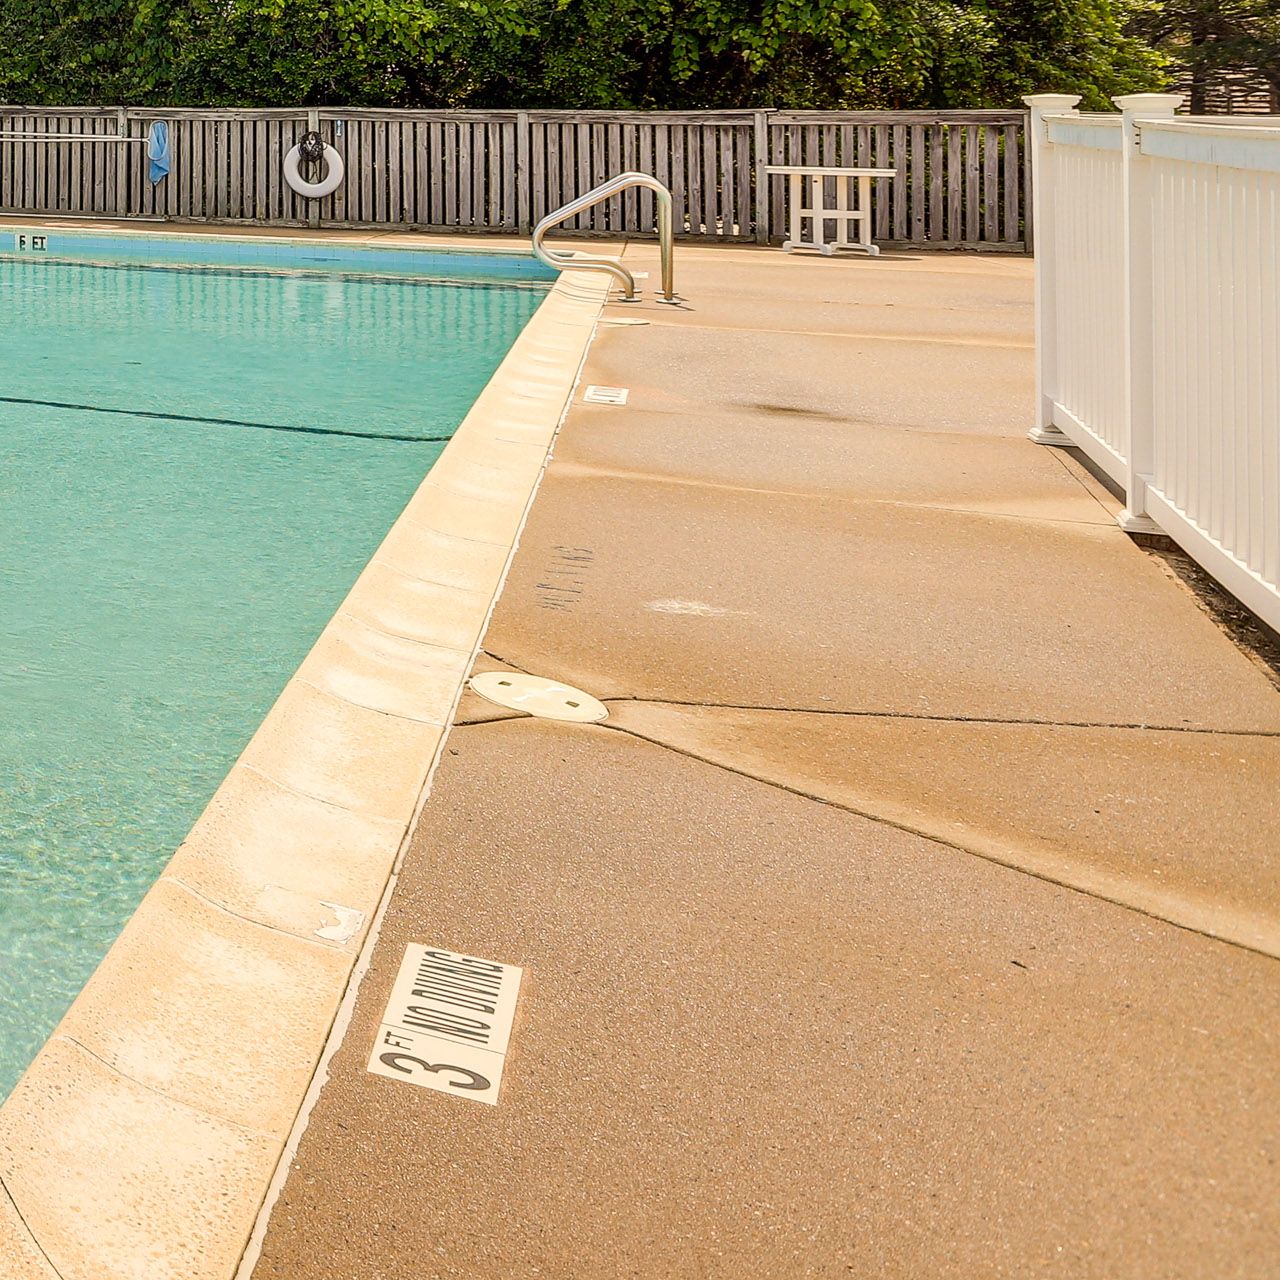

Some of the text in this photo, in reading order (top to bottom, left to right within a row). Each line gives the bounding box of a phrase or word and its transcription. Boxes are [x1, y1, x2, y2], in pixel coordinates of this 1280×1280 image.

[402, 950, 504, 1044] NO DIVING
[379, 1031, 491, 1091] 3 FT
